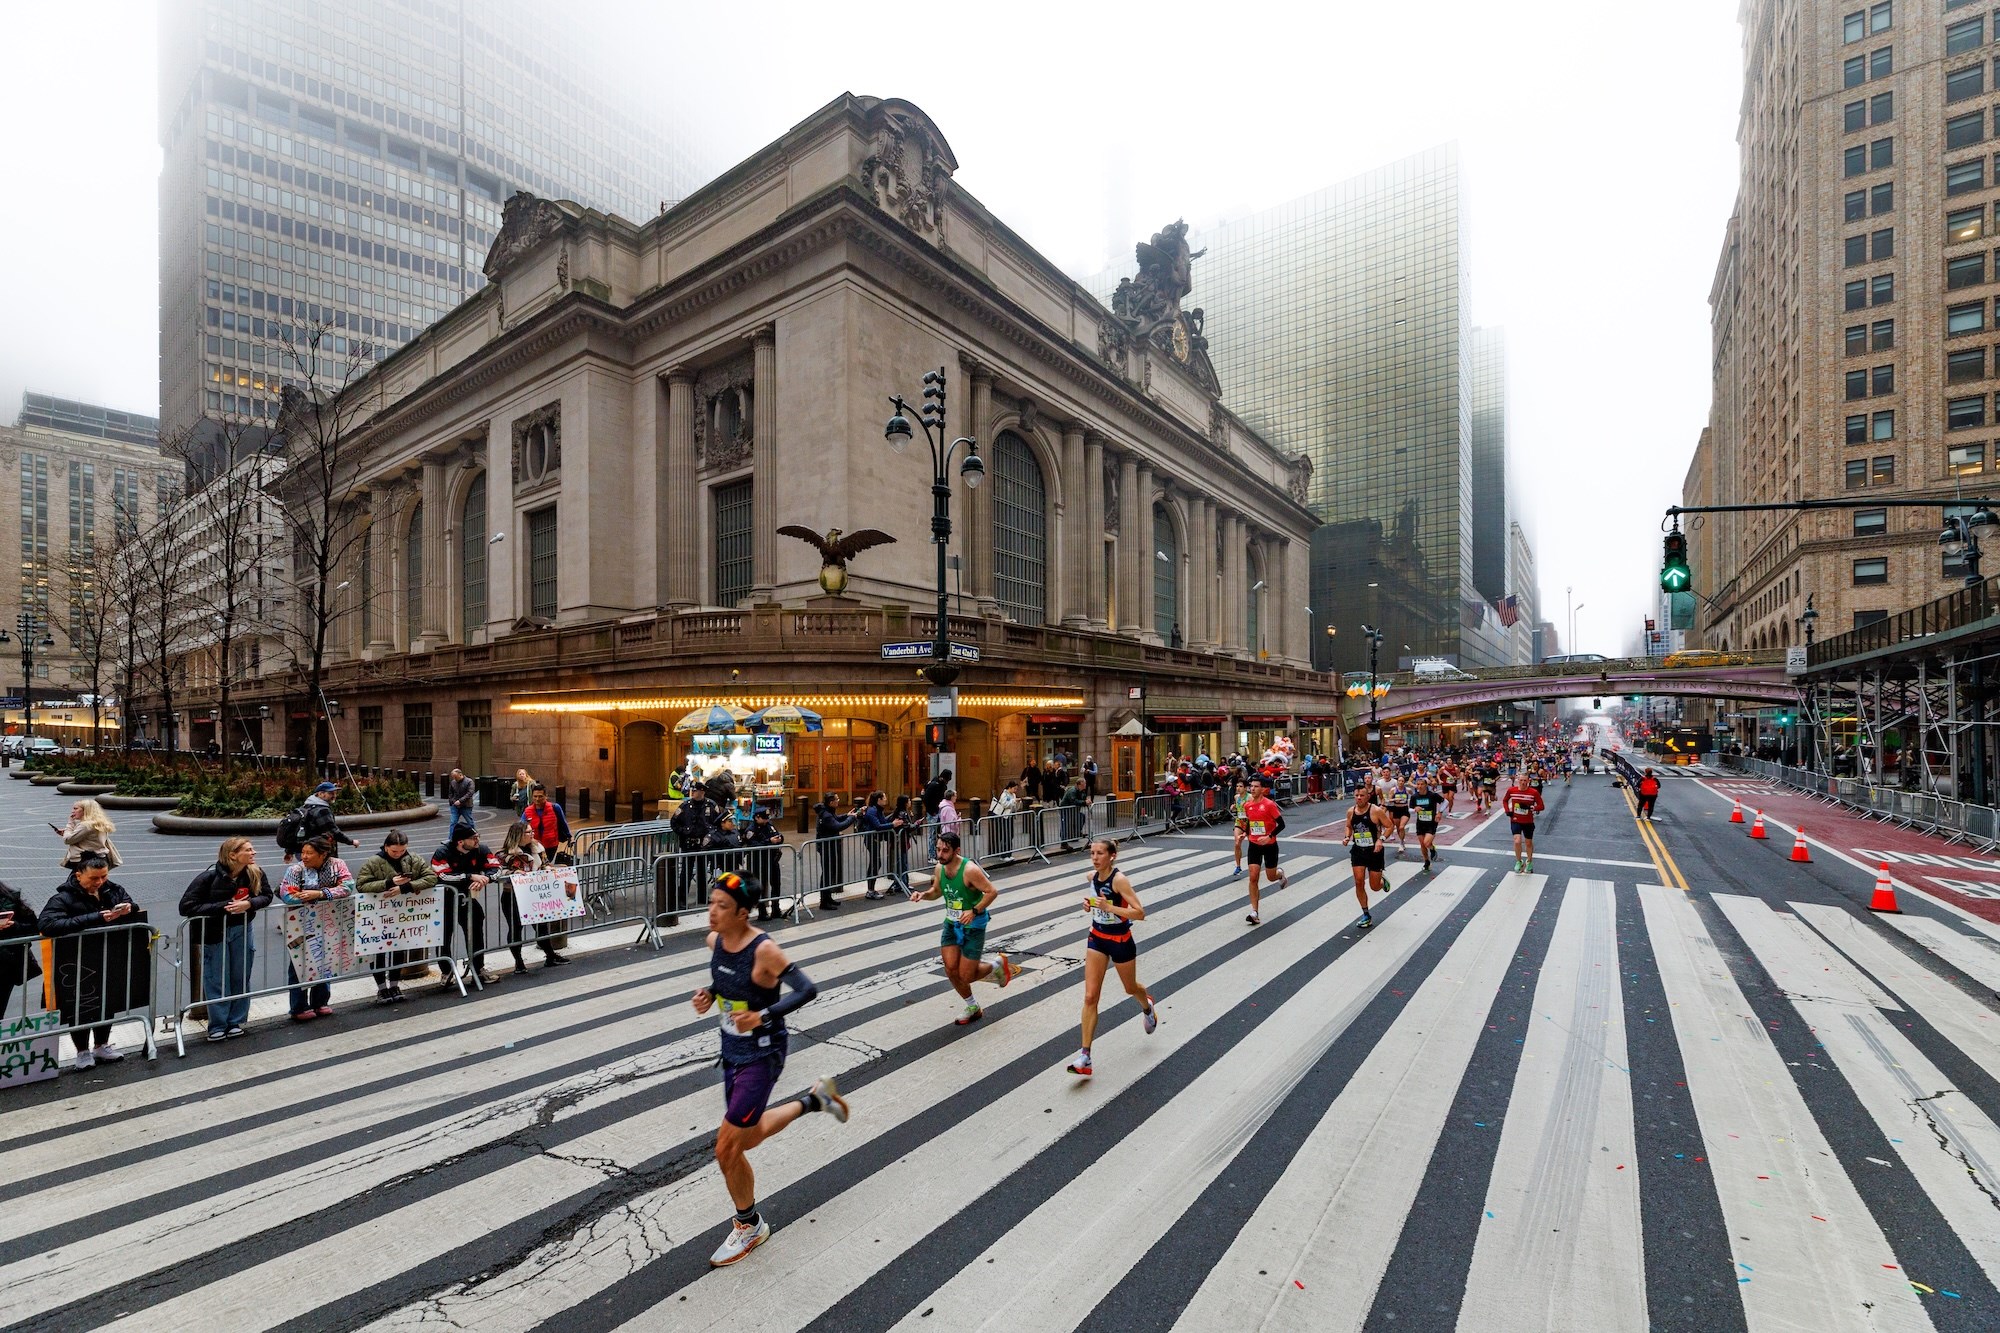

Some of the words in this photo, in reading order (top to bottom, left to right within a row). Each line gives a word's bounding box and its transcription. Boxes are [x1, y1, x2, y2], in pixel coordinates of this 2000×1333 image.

[883, 646, 917, 656] Vanderbilt
[918, 645, 932, 655] Ave
[951, 646, 961, 655] East
[962, 648, 974, 658] 42nd
[973, 650, 979, 659] St
[1790, 657, 1805, 665] 25
[1640, 682, 1708, 690] PERSHING
[1717, 683, 1772, 694] SQUARE
[1411, 699, 1446, 710] GRAND
[1453, 691, 1502, 702] CENTRAL
[1509, 685, 1569, 696] TERMINAL
[1850, 848, 2000, 872] ONL
[536, 875, 548, 883] OUT
[529, 883, 550, 892] COACH
[553, 880, 560, 889] G
[539, 892, 552, 900] HAS
[357, 902, 375, 912] EVEN
[379, 900, 390, 909] IF
[391, 899, 402, 908] YOU
[405, 897, 436, 907] FINISH
[532, 898, 565, 912] STAMINA
[361, 917, 374, 926] IN
[379, 915, 395, 924] THE
[399, 913, 431, 922] BOTTOM
[381, 930, 398, 940] STILL
[399, 929, 406, 939] A
[407, 925, 428, 937] TOP!
[0, 1011, 59, 1038] HATS
